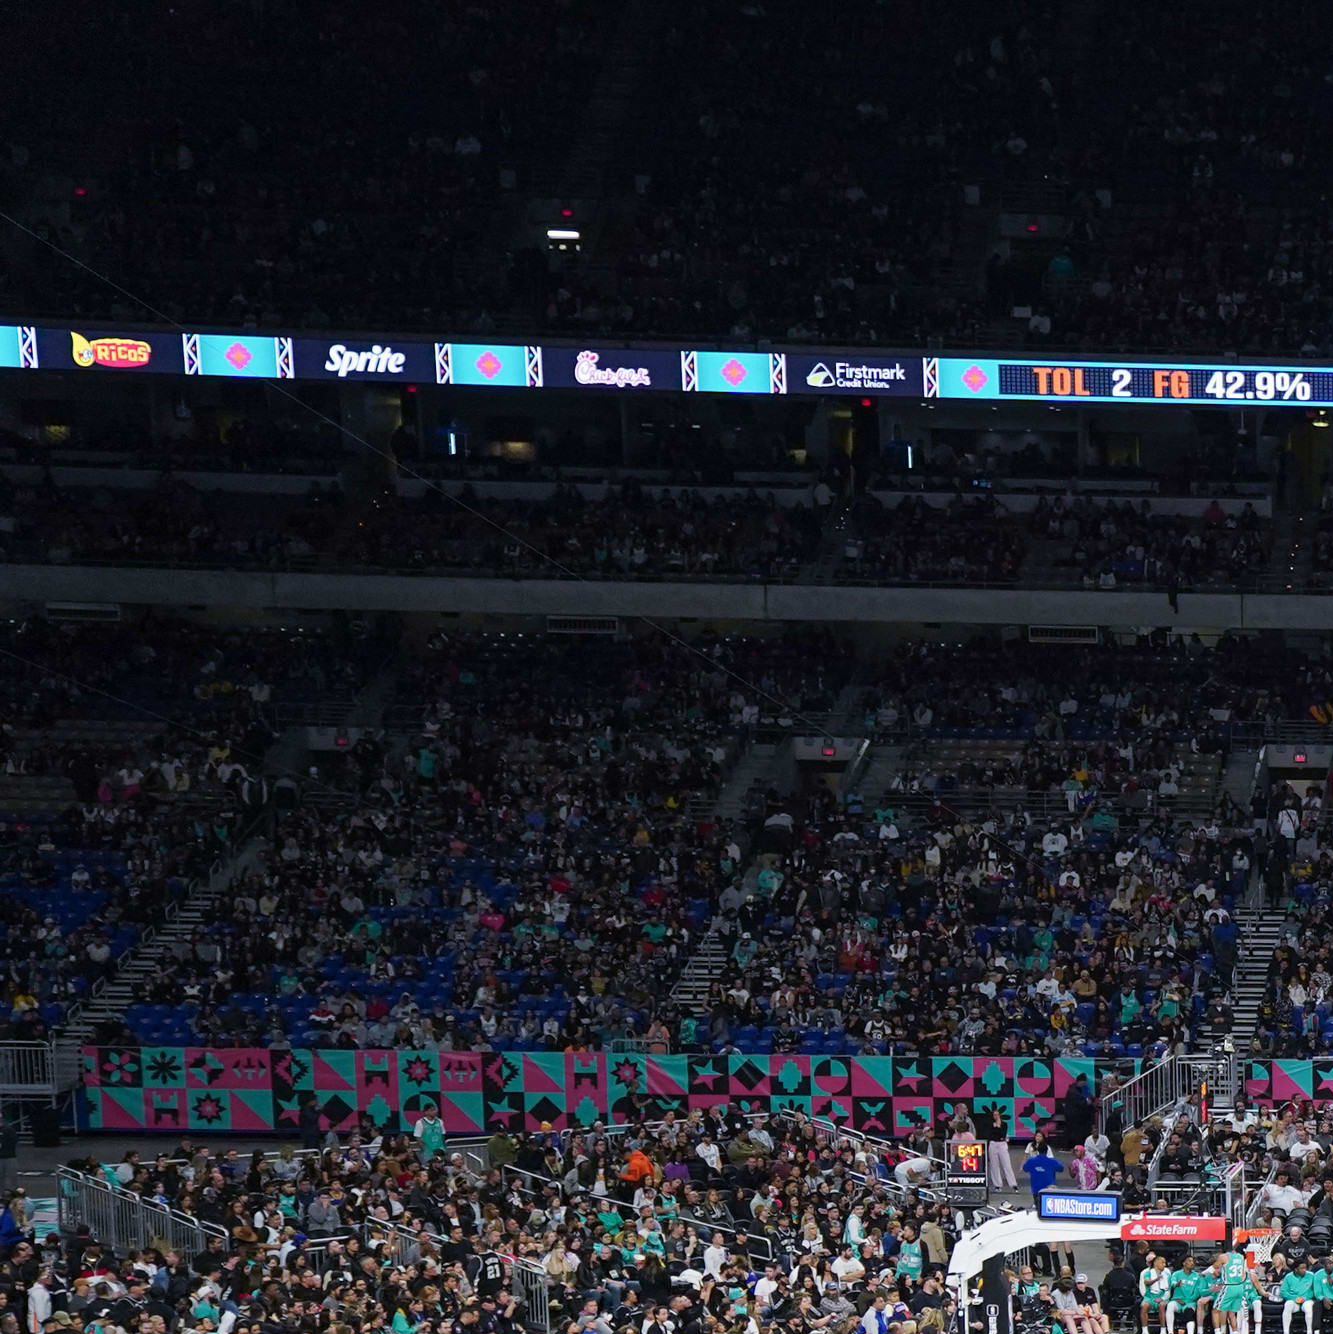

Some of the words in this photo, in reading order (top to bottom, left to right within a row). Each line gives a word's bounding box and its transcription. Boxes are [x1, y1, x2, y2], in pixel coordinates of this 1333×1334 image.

[324, 344, 407, 378] Sprite
[836, 362, 906, 381] Firstmark
[836, 379, 862, 388] Credit
[1033, 366, 1091, 397] TOL
[1111, 368, 1132, 398] 2
[1154, 369, 1191, 399] FG
[1205, 371, 1311, 401] 42.9%
[957, 1143, 983, 1158] 6:47
[961, 1157, 978, 1172] 14
[1054, 1198, 1112, 1216] NBAStore.com
[486, 1264, 501, 1279] 21
[1228, 1264, 1243, 1277] 33
